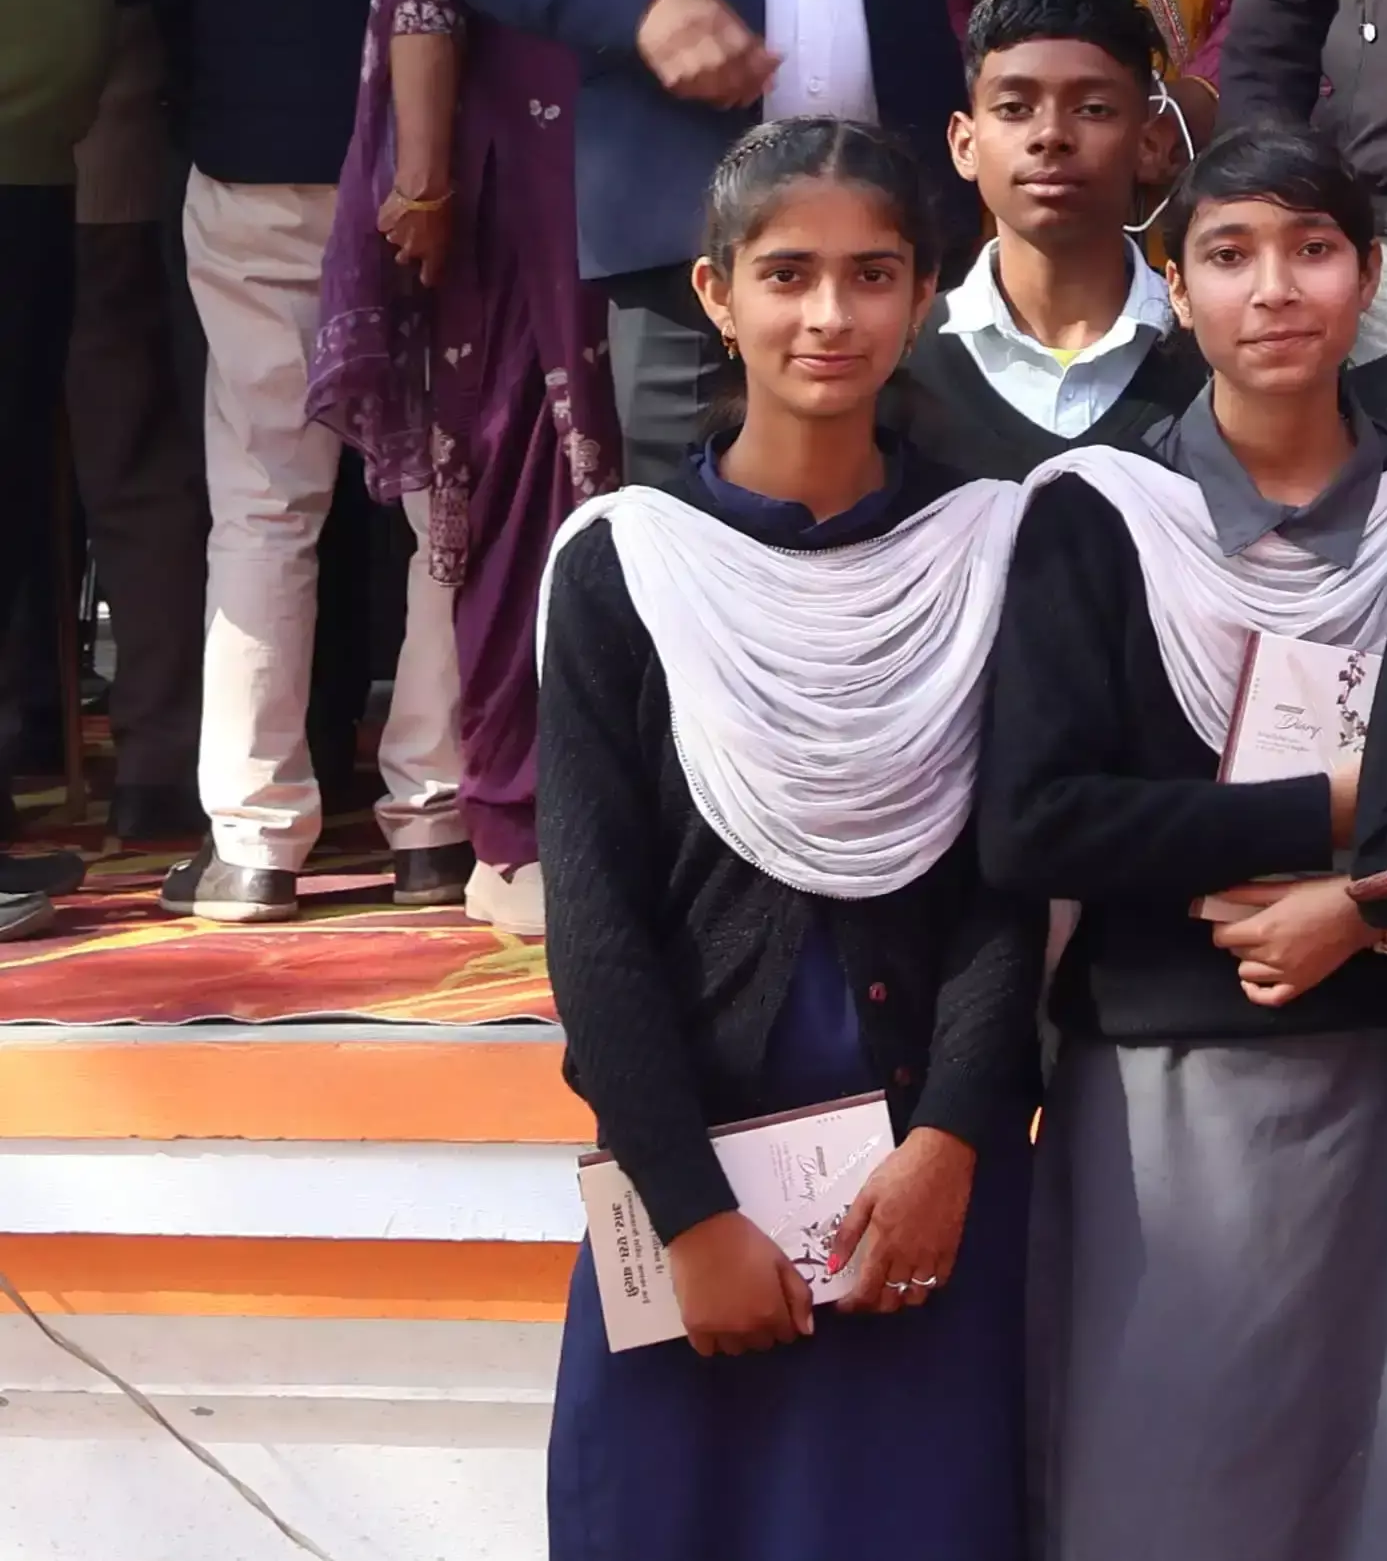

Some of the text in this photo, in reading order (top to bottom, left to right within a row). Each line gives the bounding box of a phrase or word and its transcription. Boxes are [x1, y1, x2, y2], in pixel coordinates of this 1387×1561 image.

[1275, 713, 1323, 740] Diary
[796, 1154, 817, 1202] Diary
[611, 1202, 640, 1298] आर. एस. बाली
